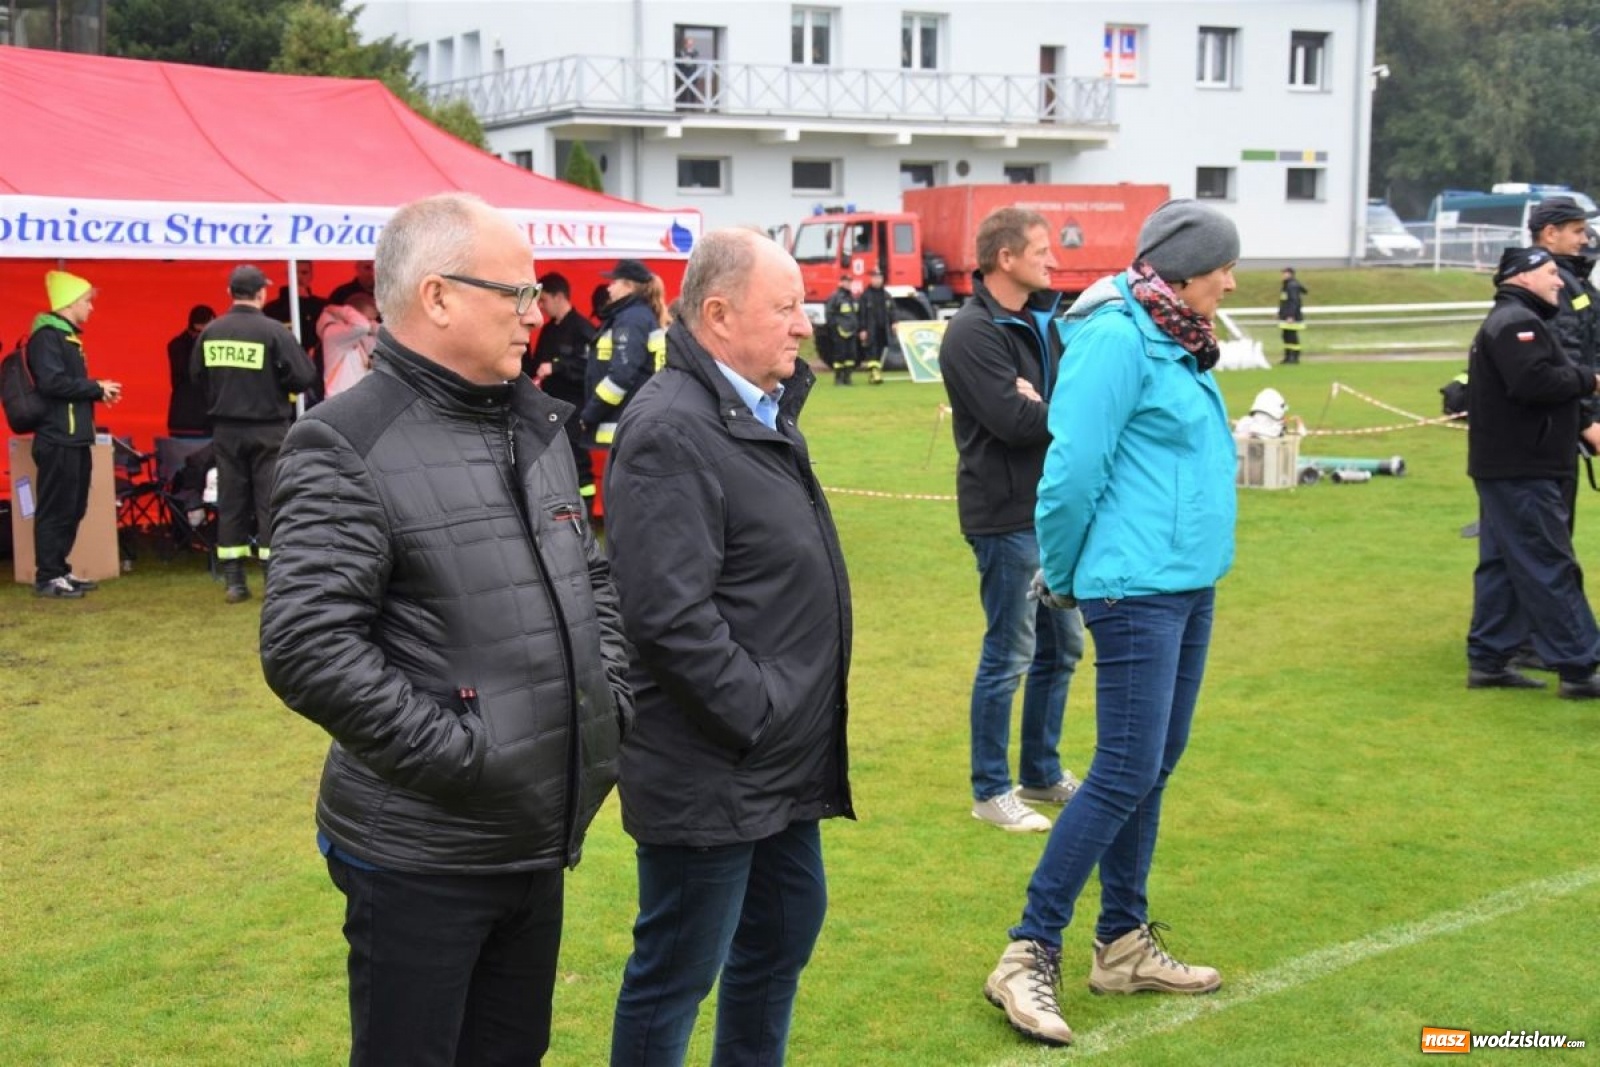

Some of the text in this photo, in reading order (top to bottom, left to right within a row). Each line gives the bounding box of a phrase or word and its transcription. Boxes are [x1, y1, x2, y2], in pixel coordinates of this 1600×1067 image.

[164, 212, 274, 246] Straż
[289, 213, 384, 246] Poża
[518, 223, 607, 246] LIN II
